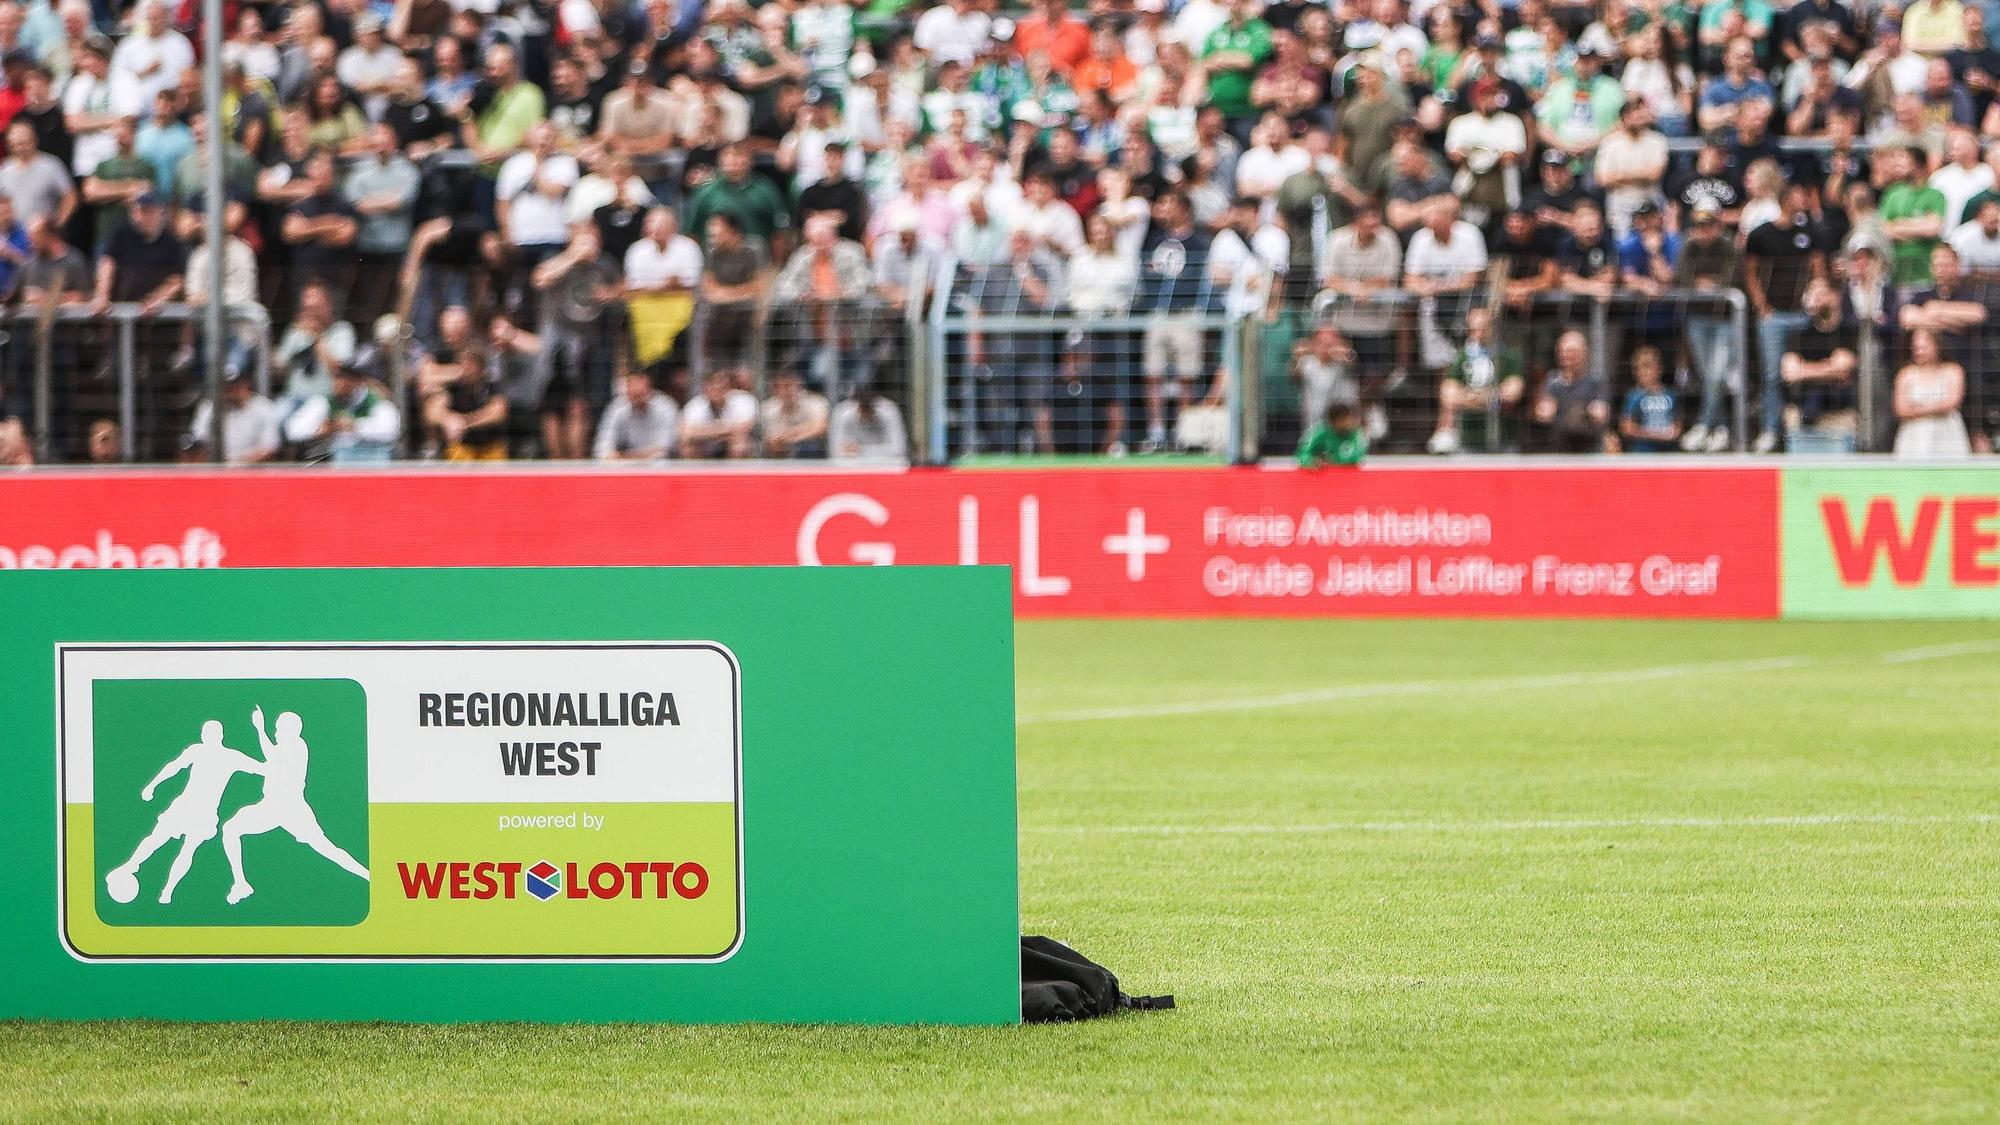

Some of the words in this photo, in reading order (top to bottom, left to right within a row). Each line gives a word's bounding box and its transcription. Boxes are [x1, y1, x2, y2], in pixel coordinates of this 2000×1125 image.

[1203, 506, 1295, 547] Freie
[1296, 506, 1492, 547] Architekten
[1203, 554, 1314, 597] Grube
[1640, 554, 1721, 597] Graf
[418, 691, 681, 727] REGIONALLIGA
[499, 741, 602, 776] WEST
[498, 811, 577, 831] powered
[582, 811, 606, 831] by
